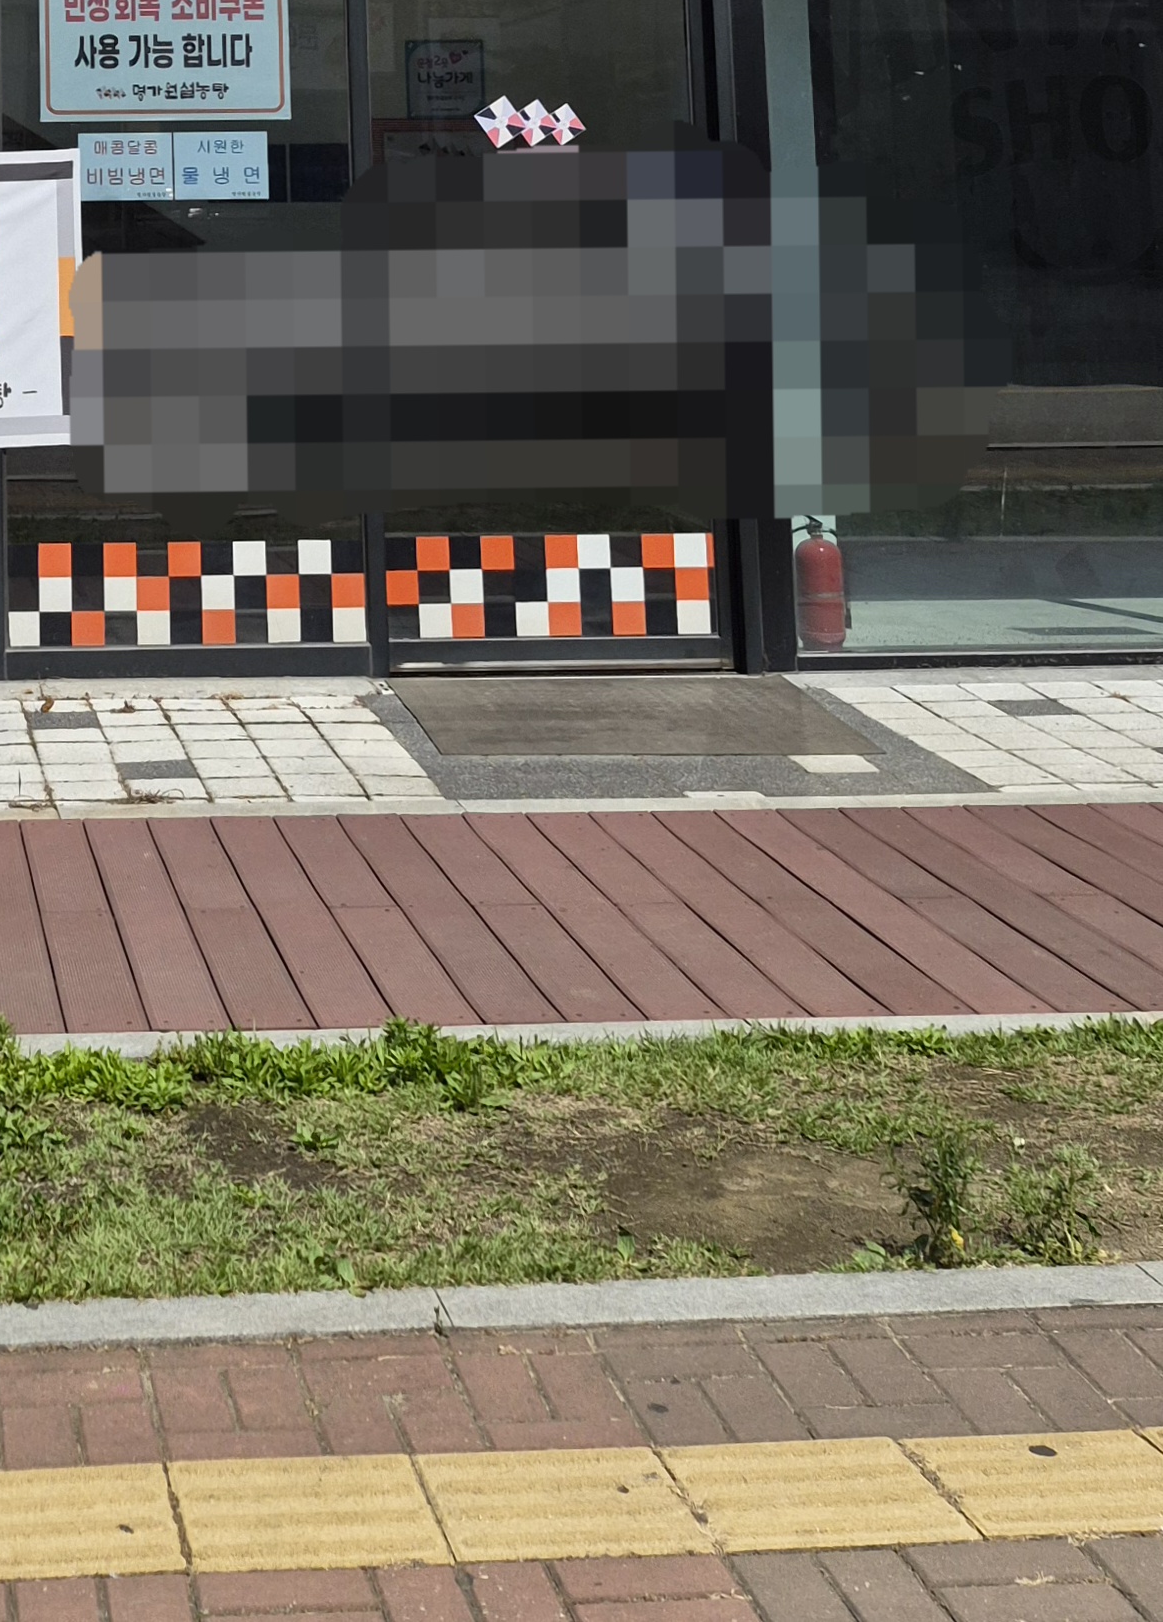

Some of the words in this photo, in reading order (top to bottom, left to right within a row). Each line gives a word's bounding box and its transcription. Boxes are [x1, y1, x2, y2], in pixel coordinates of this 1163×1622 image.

[74, 34, 120, 70] 사용
[132, 81, 230, 102] 명가원설농탕
[197, 139, 245, 155] 시원한
[87, 166, 167, 186] 비빔냉면
